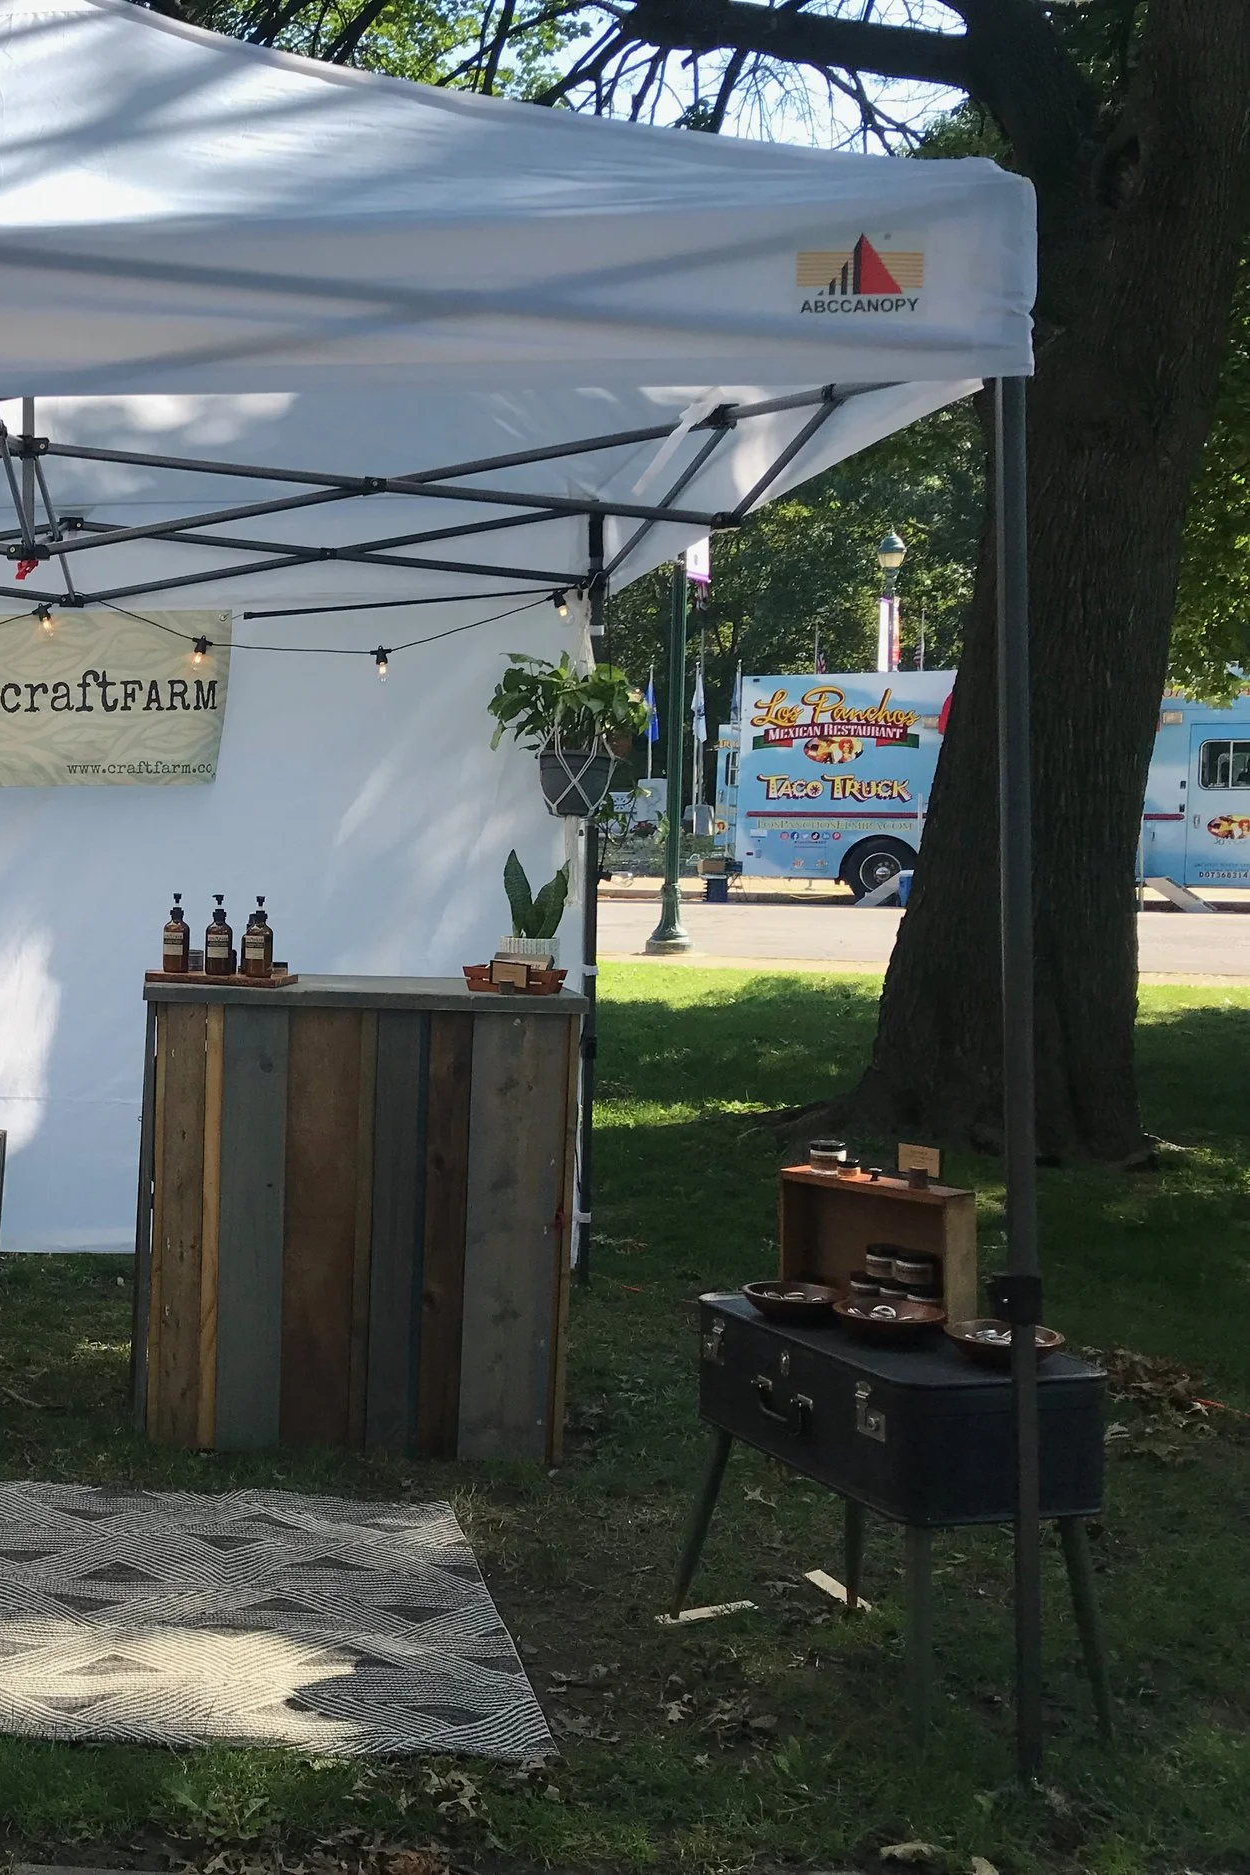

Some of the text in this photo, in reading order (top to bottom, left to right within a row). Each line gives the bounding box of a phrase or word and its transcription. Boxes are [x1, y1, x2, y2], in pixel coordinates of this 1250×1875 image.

[800, 298, 919, 314] ABCCANOPY
[0, 669, 218, 713] craftFARM
[751, 685, 921, 727] Los Panchos
[768, 723, 904, 741] MEXICAN RESTAURANT
[757, 774, 913, 803] TACO TRUCK
